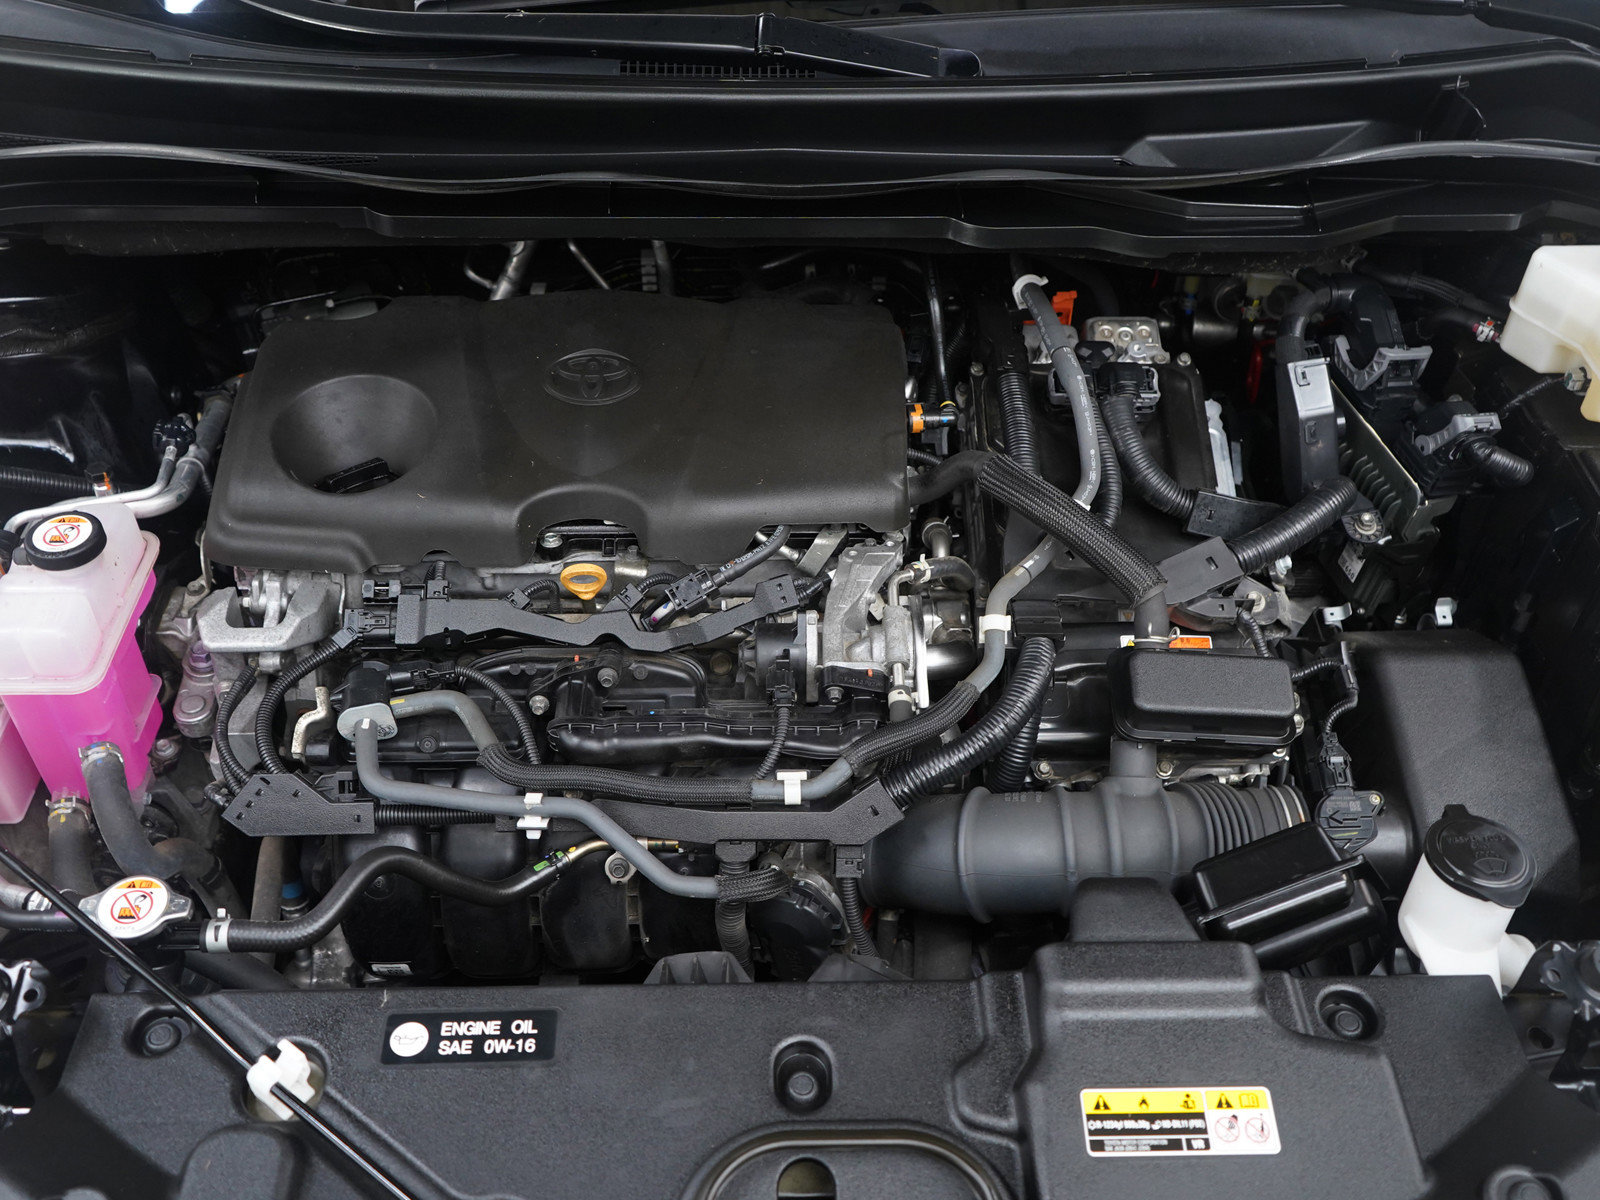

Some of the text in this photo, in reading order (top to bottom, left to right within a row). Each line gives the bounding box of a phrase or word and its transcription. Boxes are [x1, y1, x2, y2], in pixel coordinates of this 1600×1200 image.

[440, 1019, 538, 1036] ENGINE OIL
[438, 1038, 536, 1055] SAE 0W-16
